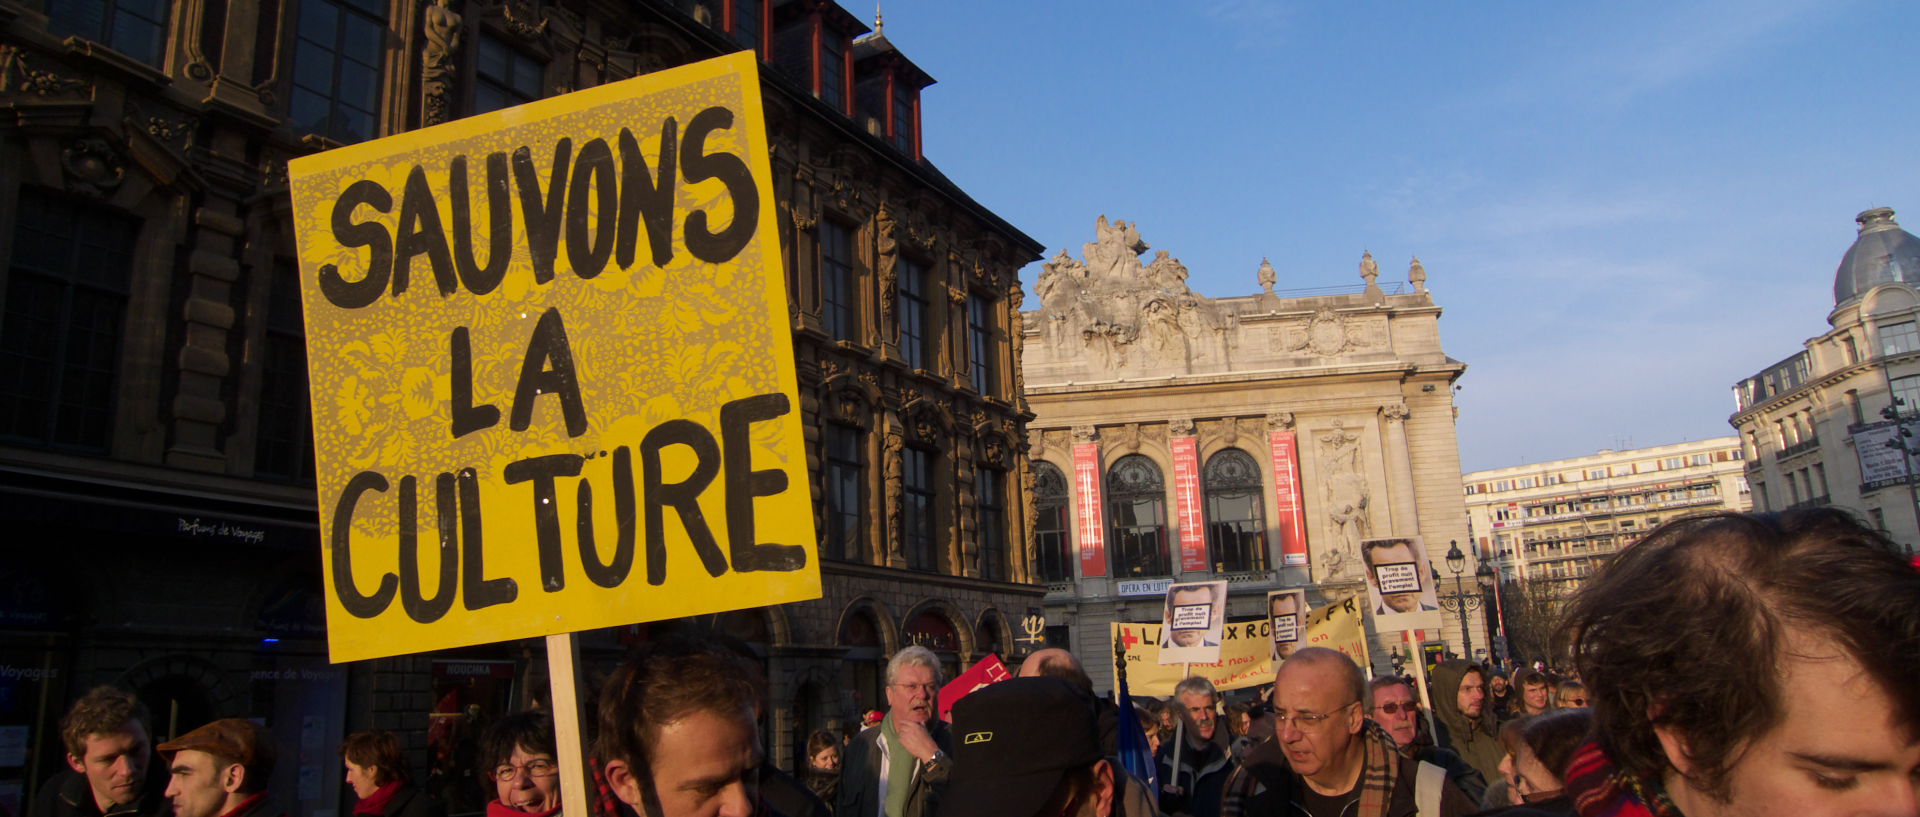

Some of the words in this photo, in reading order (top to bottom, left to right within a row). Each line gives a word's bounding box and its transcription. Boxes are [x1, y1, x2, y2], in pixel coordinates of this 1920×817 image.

[318, 106, 760, 309] SAUVONS
[451, 307, 588, 439] LA
[332, 392, 806, 623] CULTURE
[447, 664, 491, 675] NOUCHKA
[1229, 656, 1255, 666] nous
